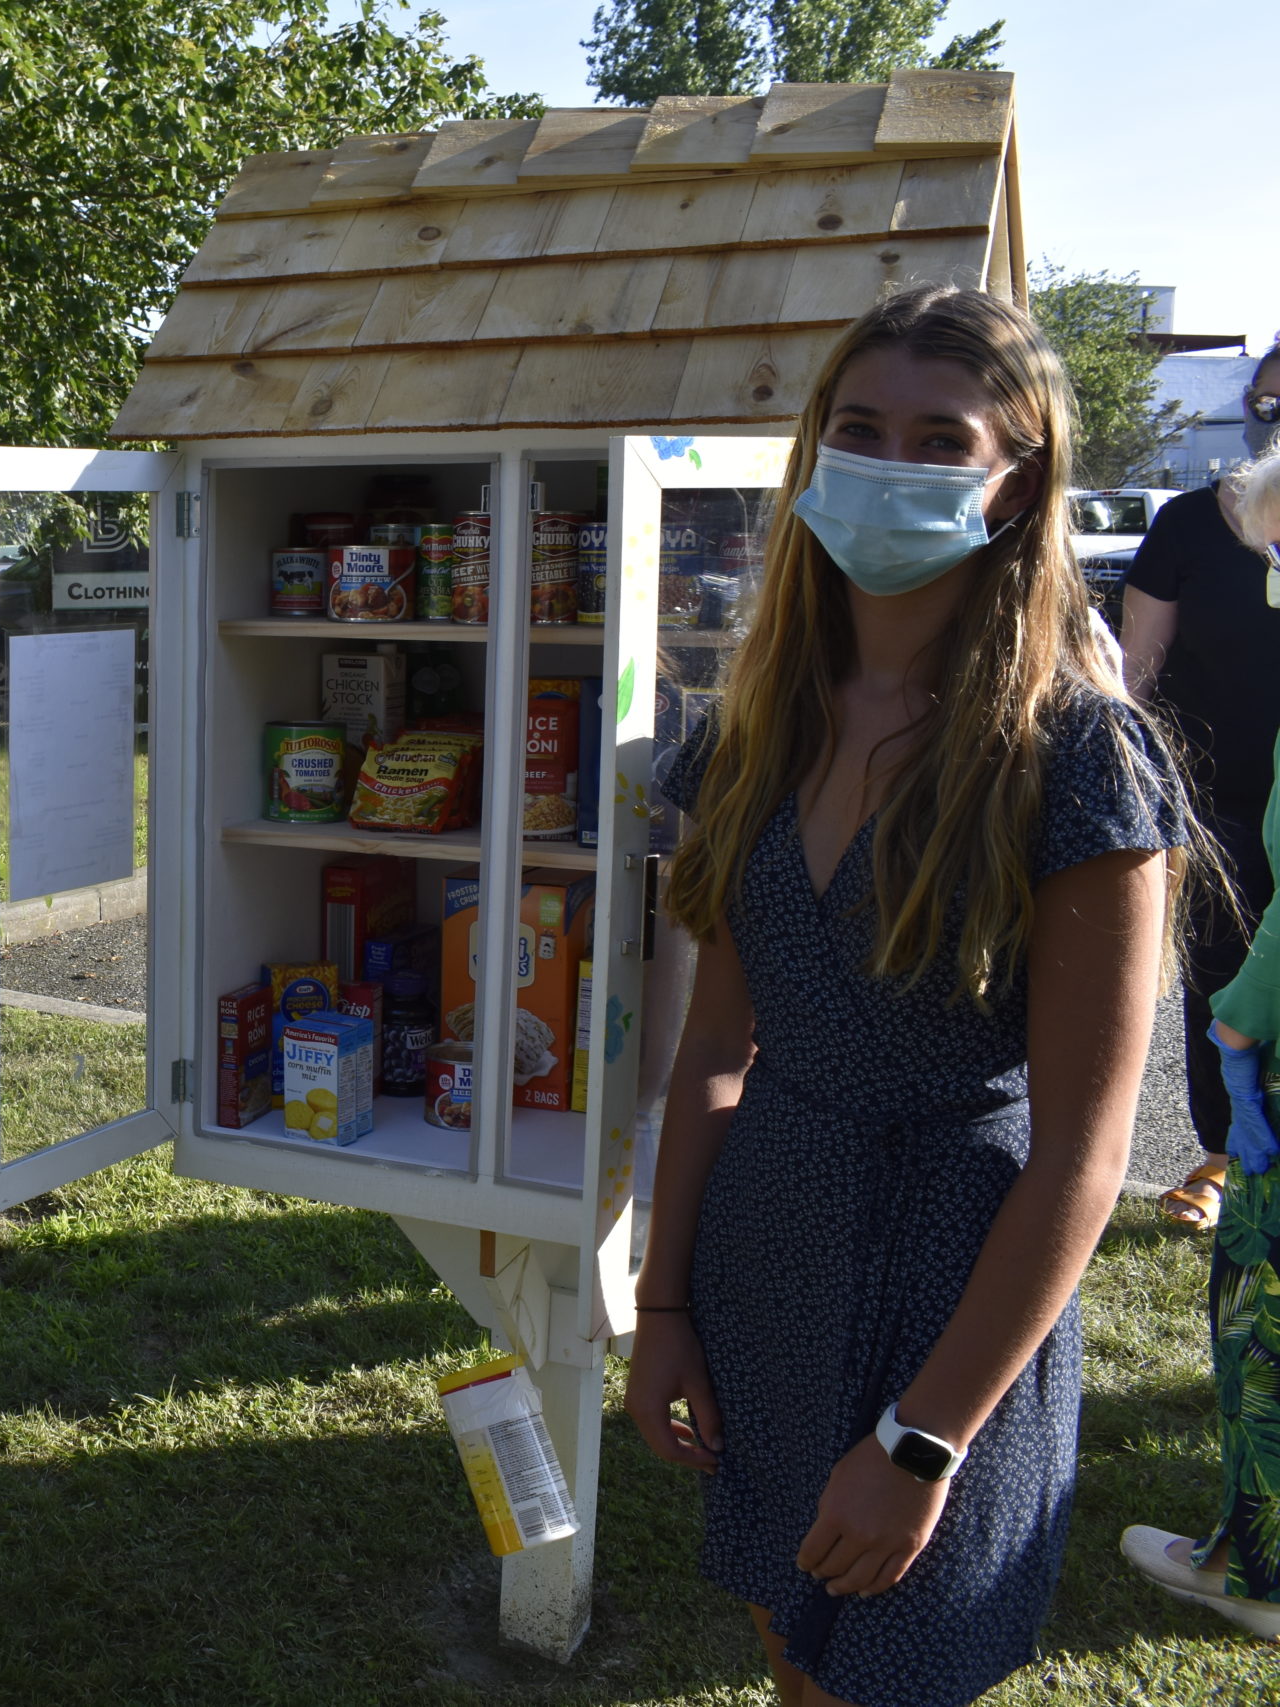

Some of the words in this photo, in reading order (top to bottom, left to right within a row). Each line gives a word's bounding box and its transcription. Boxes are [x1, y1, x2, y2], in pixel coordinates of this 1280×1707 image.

[453, 534, 490, 548] CHUNKY
[533, 532, 577, 546] CHUNKY
[578, 530, 607, 548] OY
[299, 556, 320, 569] WHITE
[349, 552, 381, 565] Dinty
[347, 563, 384, 573] Moore
[532, 569, 568, 581] EGETABLE
[326, 679, 380, 692] CHICKEN
[332, 692, 374, 705] STOCK
[528, 716, 559, 731] ICE
[526, 740, 558, 753] ONI
[291, 758, 334, 769] CRUSHED
[295, 769, 330, 777] TOMATOES
[376, 764, 429, 777] Ramen
[374, 782, 419, 796] Chicken
[460, 893, 480, 906] CRUN
[220, 1000, 237, 1008] RICE
[220, 1007, 238, 1015] RONI
[247, 1004, 265, 1023] RICE
[248, 1023, 266, 1045] RONI
[285, 1028, 311, 1041] America's
[311, 1033, 336, 1044] Favorite
[285, 1043, 335, 1067] JIFFY
[287, 1061, 304, 1071] corn
[306, 1063, 332, 1076] muffin
[301, 1071, 317, 1081] mix
[525, 1089, 532, 1103] 2
[534, 1090, 560, 1106] BAGS
